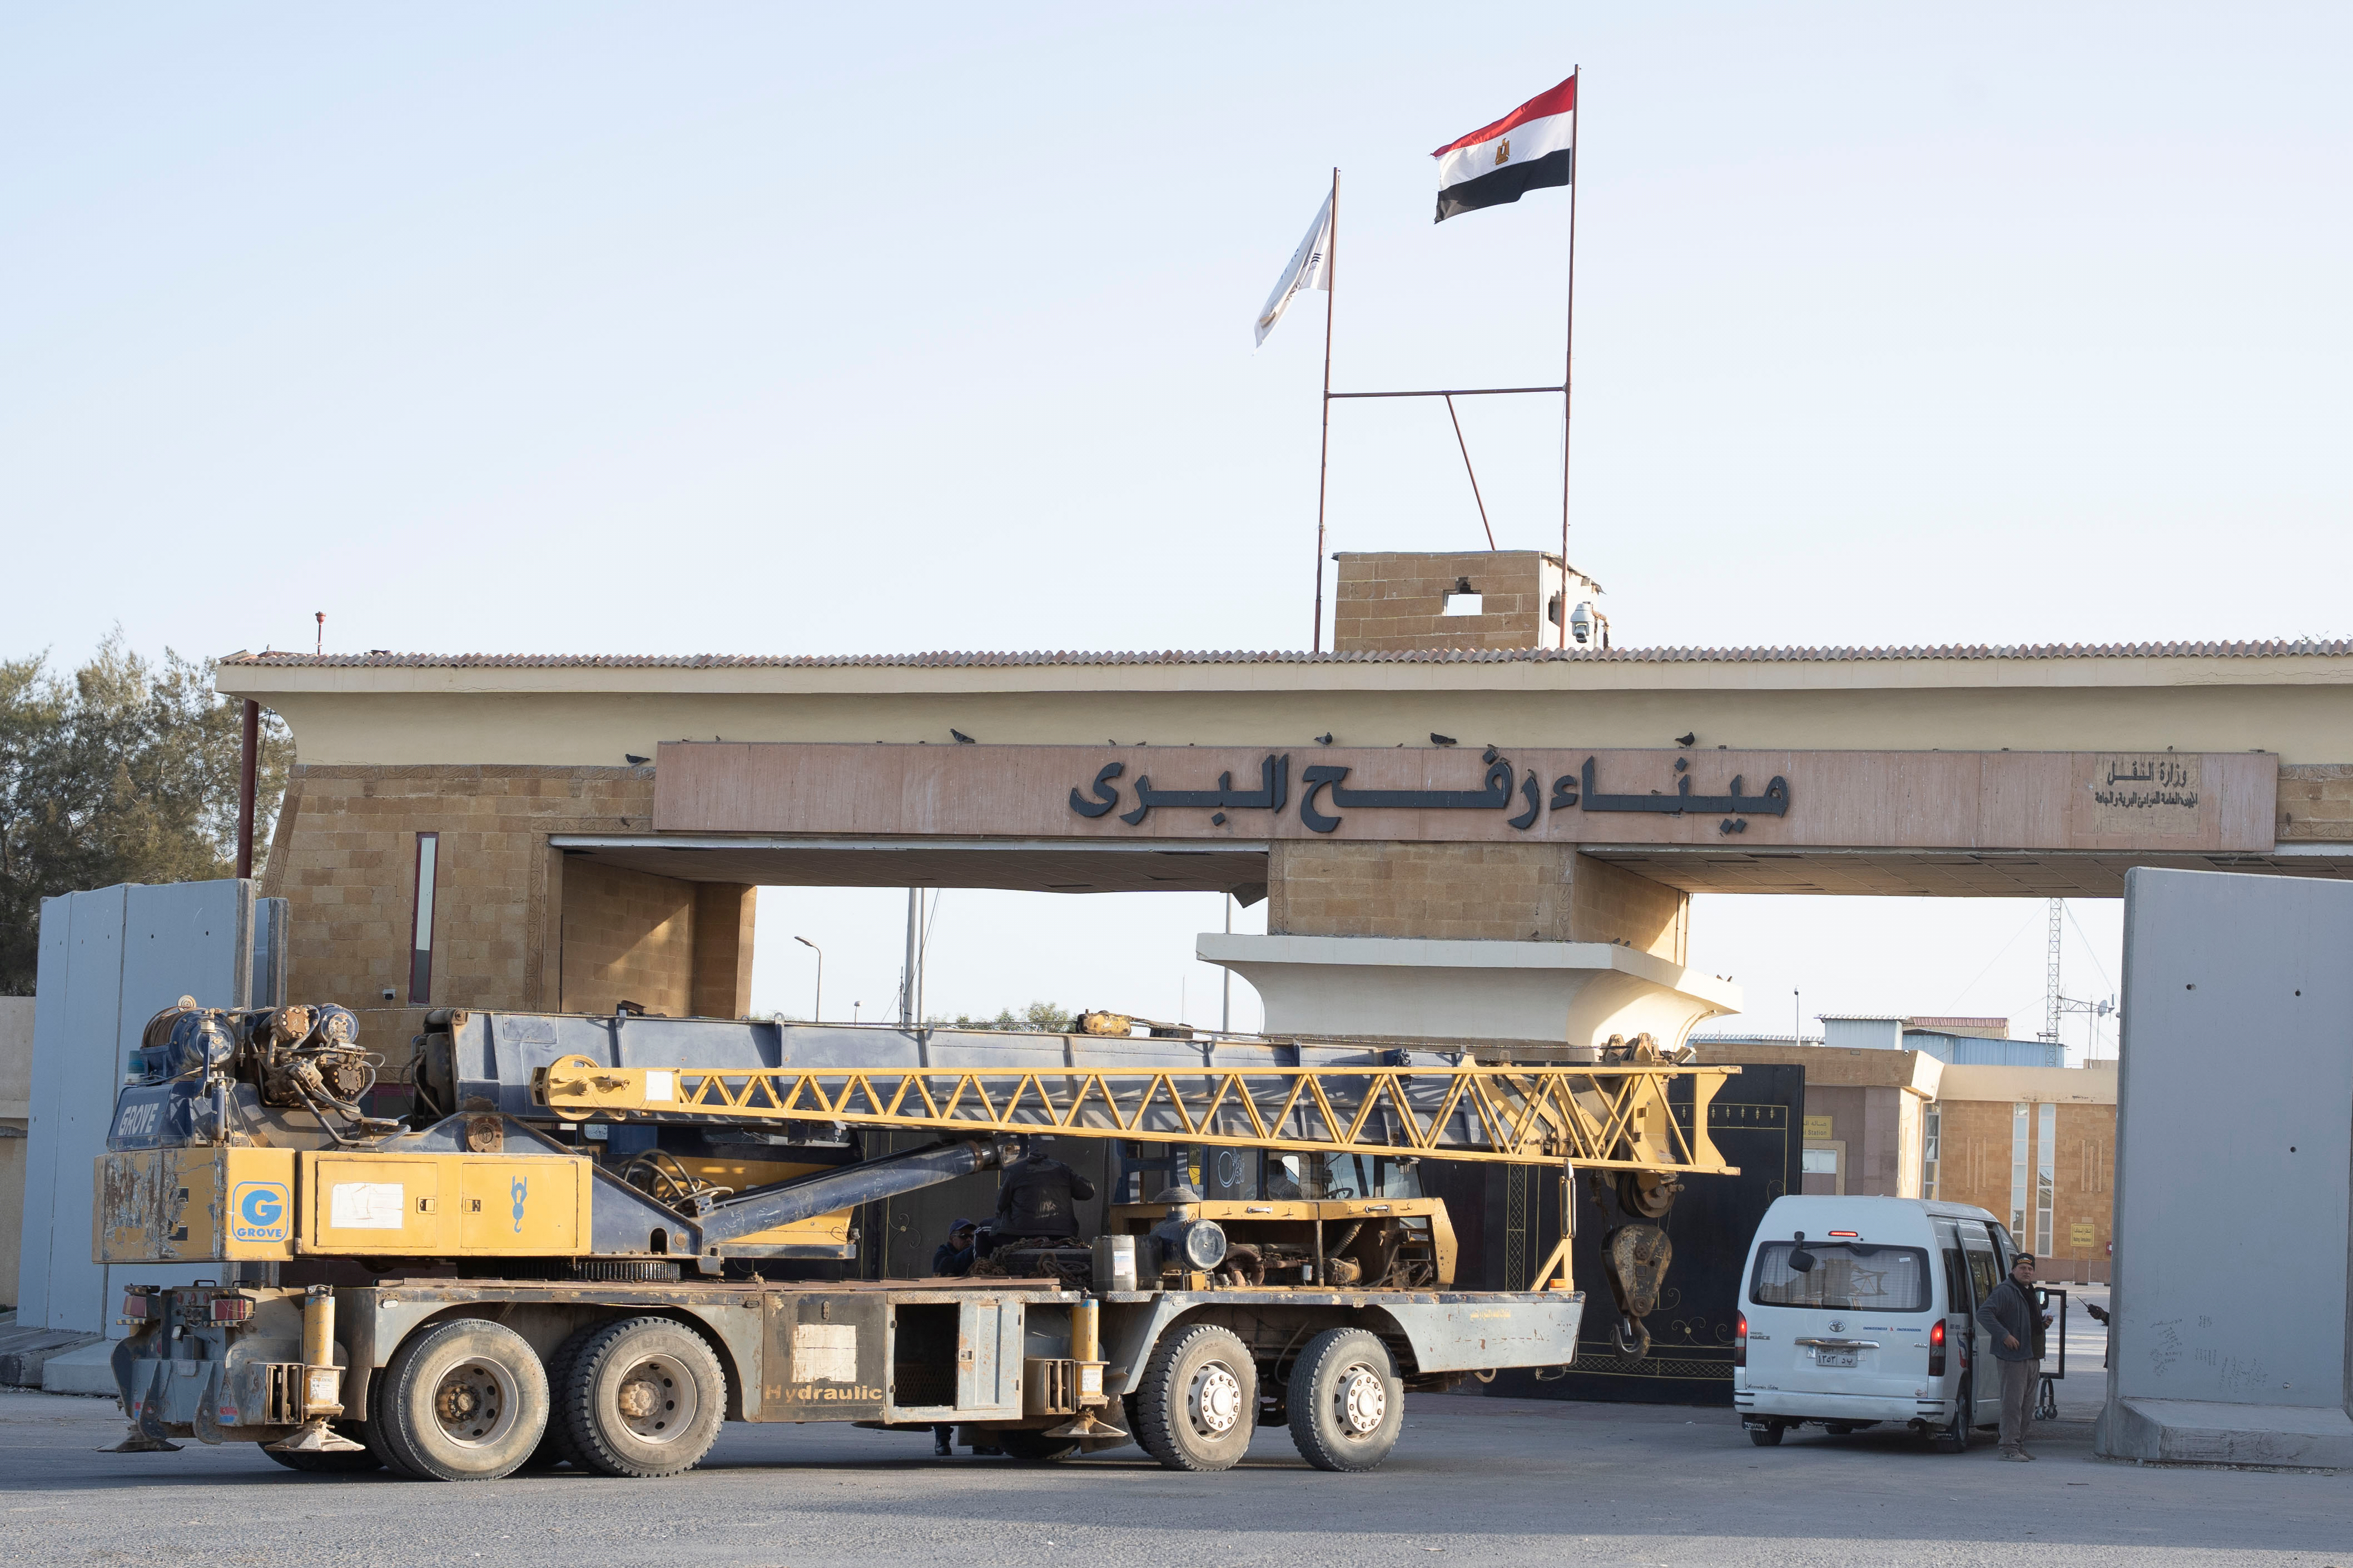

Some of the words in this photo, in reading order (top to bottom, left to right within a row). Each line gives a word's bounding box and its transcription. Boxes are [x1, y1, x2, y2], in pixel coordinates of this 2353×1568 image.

[2107, 760, 2154, 786] النقل
[2160, 761, 2187, 788] وزارة
[1299, 748, 1541, 833] رفح
[1549, 754, 1790, 835] ميناء
[2118, 791, 2137, 808] البرية
[2161, 791, 2180, 805] العامة
[118, 1102, 160, 1137] GROVE
[241, 1189, 282, 1227] G
[237, 1227, 282, 1238] GROVE
[765, 1383, 883, 1403] Hydraulic
